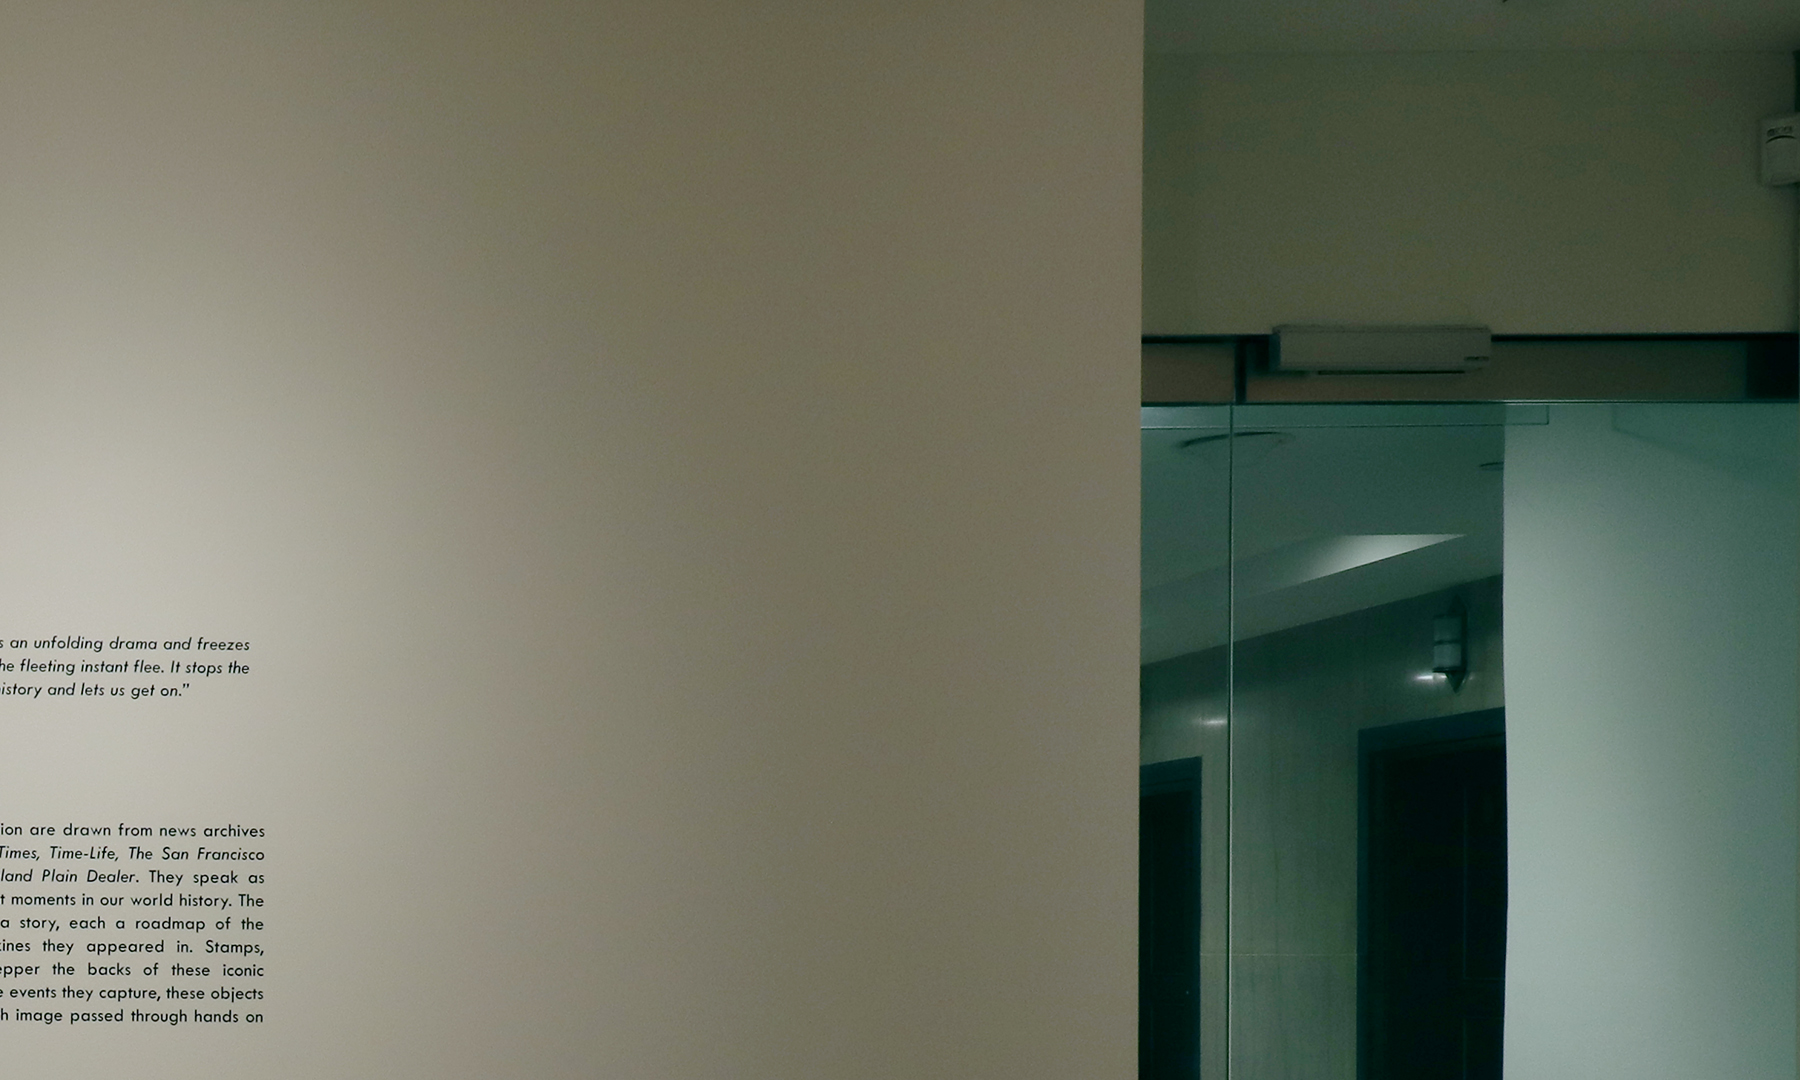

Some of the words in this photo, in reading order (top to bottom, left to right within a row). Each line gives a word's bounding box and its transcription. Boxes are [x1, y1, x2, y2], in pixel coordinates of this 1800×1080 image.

[9, 639, 28, 649] an
[33, 634, 104, 654] unfolding
[108, 635, 158, 651] drama
[162, 636, 193, 651] and
[196, 636, 251, 652] freezes
[19, 657, 76, 677] fleeting
[80, 658, 130, 674] instant
[133, 658, 165, 674] flee.
[170, 659, 181, 674] It
[184, 661, 223, 678] stops
[227, 659, 250, 675] the
[47, 681, 77, 697] and
[80, 681, 106, 697] lets
[110, 686, 126, 697] us
[130, 683, 156, 701] get
[29, 826, 56, 837] are
[62, 822, 112, 837] drawn
[117, 822, 153, 837] from
[159, 827, 197, 838] news
[203, 823, 266, 838] archives
[49, 845, 120, 863] Time-Life,
[128, 845, 154, 861] The
[161, 845, 190, 861] San
[196, 846, 265, 861] Francisco
[41, 868, 78, 883] Plain
[86, 868, 140, 884] Dealer.
[148, 869, 184, 888] They
[192, 869, 239, 888] speak
[247, 874, 265, 885] as
[10, 894, 77, 907] moments
[81, 892, 95, 906] in
[99, 896, 125, 907] our
[129, 892, 174, 907] world
[178, 892, 233, 911] history.
[237, 893, 265, 908] The
[0, 918, 10, 929] a
[19, 917, 60, 933] story,
[68, 915, 106, 930] each
[115, 919, 126, 930] a
[135, 915, 206, 934] roadmap
[214, 916, 232, 931] of
[240, 916, 265, 931] the
[41, 938, 75, 956] they
[86, 938, 165, 957] appeared
[176, 939, 194, 954] in.
[204, 939, 265, 958] Stamps,
[51, 961, 76, 976] the
[87, 961, 132, 977] backs
[142, 961, 160, 977] of
[170, 962, 211, 977] these
[222, 963, 265, 977] iconic
[9, 986, 57, 999] events
[61, 984, 94, 1003] they
[98, 987, 162, 1003] capture,
[165, 985, 206, 1000] these
[210, 985, 265, 1004] objects
[15, 1008, 64, 1026] image
[70, 1008, 124, 1026] passed
[130, 1008, 188, 1027] through
[193, 1008, 239, 1024] hands
[245, 1013, 264, 1024] on
